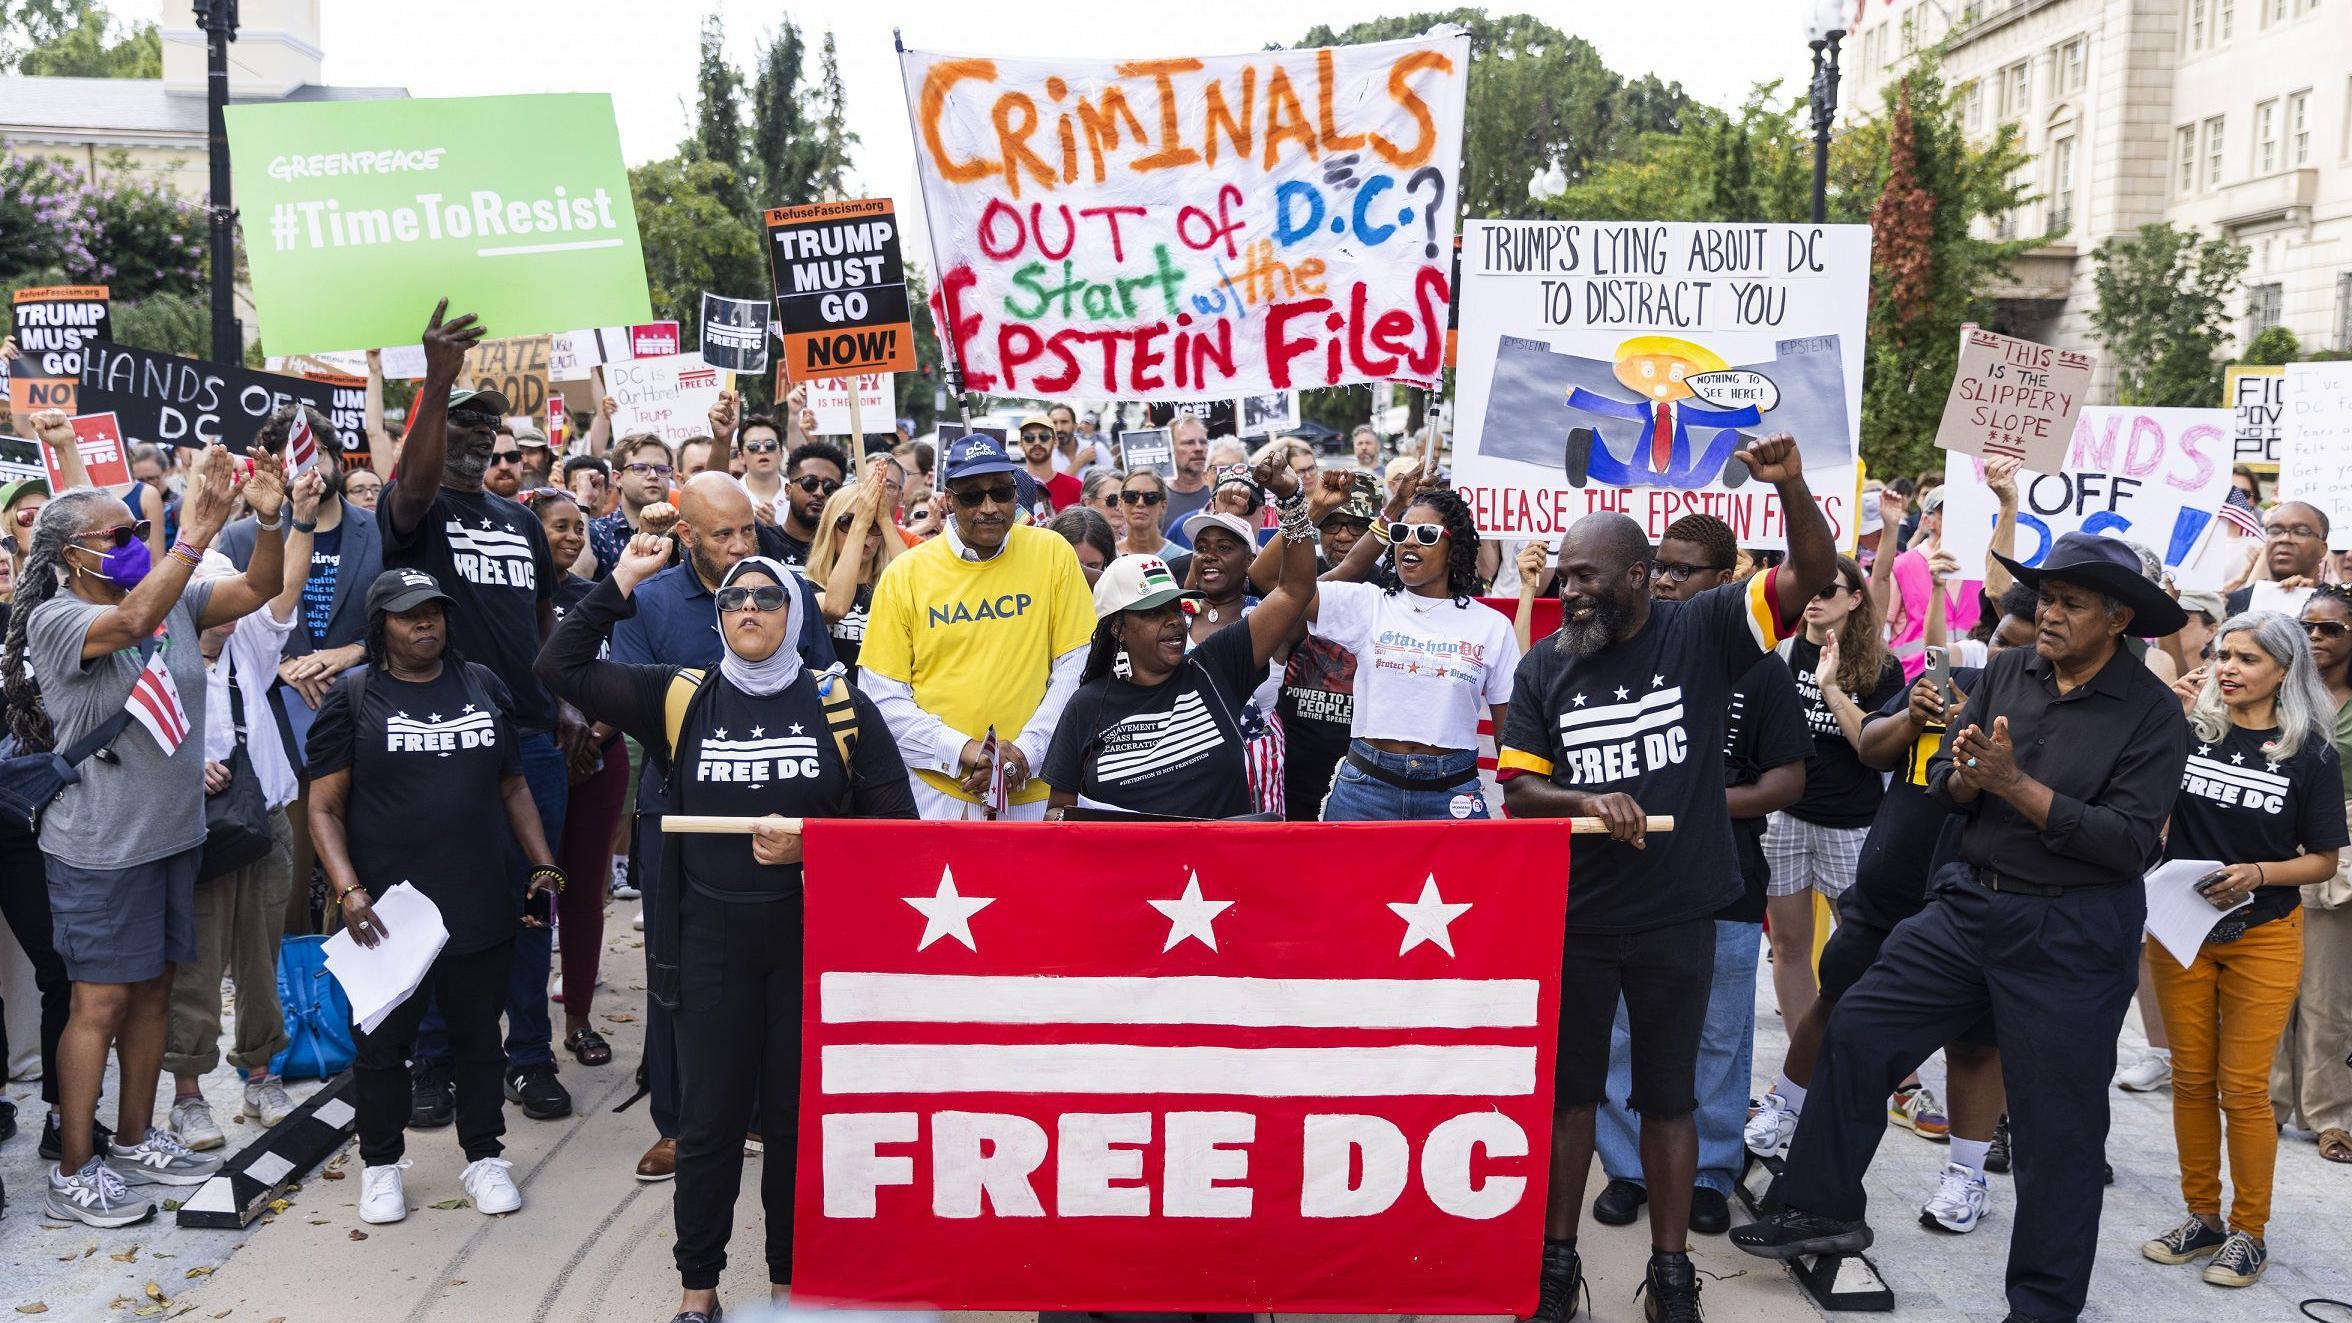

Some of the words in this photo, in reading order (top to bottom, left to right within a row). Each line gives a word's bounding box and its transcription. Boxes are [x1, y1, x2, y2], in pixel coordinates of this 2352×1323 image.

[267, 147, 446, 182] GREENPEACE
[269, 185, 617, 251] #TimeToResist
[773, 201, 884, 220] RefuseFascism.org
[776, 221, 893, 260] TRUMP
[978, 197, 1148, 262] OUT
[1482, 225, 1580, 272] TRUMP'S
[1594, 227, 1667, 275] LYING
[1688, 229, 1768, 273] ABOUT
[1787, 229, 1824, 273] DC
[792, 256, 885, 292] MUST
[1004, 244, 1187, 319] Start
[16, 303, 106, 326] TRUMP
[820, 292, 868, 323] GO
[1541, 281, 1571, 326] TO
[1586, 280, 1712, 327] DISTRACT
[1730, 282, 1786, 326] YOU
[706, 332, 739, 349] FREE
[741, 337, 762, 350] DC
[807, 330, 896, 367] NOW!
[1504, 337, 1545, 352] EPSTEIN
[1781, 337, 1833, 355] EPSTEIN
[2001, 339, 2055, 367] THIS
[42, 352, 82, 375] GO
[614, 367, 644, 386] DC
[1988, 363, 2004, 378] IS
[2016, 370, 2049, 388] THE
[82, 347, 226, 411] HANDS
[679, 380, 703, 390] FREE
[705, 378, 719, 388] DC
[1697, 375, 1740, 386] NOTHING
[1746, 375, 1760, 385] TO
[28, 383, 79, 405] NO
[860, 397, 882, 407] OINT
[1703, 387, 1723, 399] SEE
[1731, 387, 1764, 400] HERE!
[1959, 377, 2072, 418] SLIPPERY
[159, 406, 222, 443] DC
[1970, 406, 2052, 438] SLOPE
[335, 430, 359, 450] O
[94, 451, 118, 464] DC
[1128, 456, 1154, 466] FREE
[1155, 455, 1169, 464] DC
[2028, 471, 2143, 516] OFF
[1763, 495, 1842, 541] FIS
[507, 558, 535, 591] DC
[928, 593, 1032, 629] NAACP
[1286, 686, 1327, 702] POWER
[1329, 692, 1344, 705] TO
[1297, 698, 1352, 718] PEOPLE
[1326, 714, 1352, 725] SPEAKS
[387, 732, 456, 752] FREE
[460, 727, 496, 749] DC
[1566, 739, 1640, 785] FREE
[1645, 725, 1688, 771] DC
[697, 759, 770, 782] FREE
[778, 757, 820, 780] DC
[1119, 771, 1155, 786] #DETENTION
[1162, 765, 1175, 774] NOT
[2242, 787, 2284, 815] DC
[821, 1109, 1257, 1218] FREE
[1299, 1104, 1529, 1221] DC
